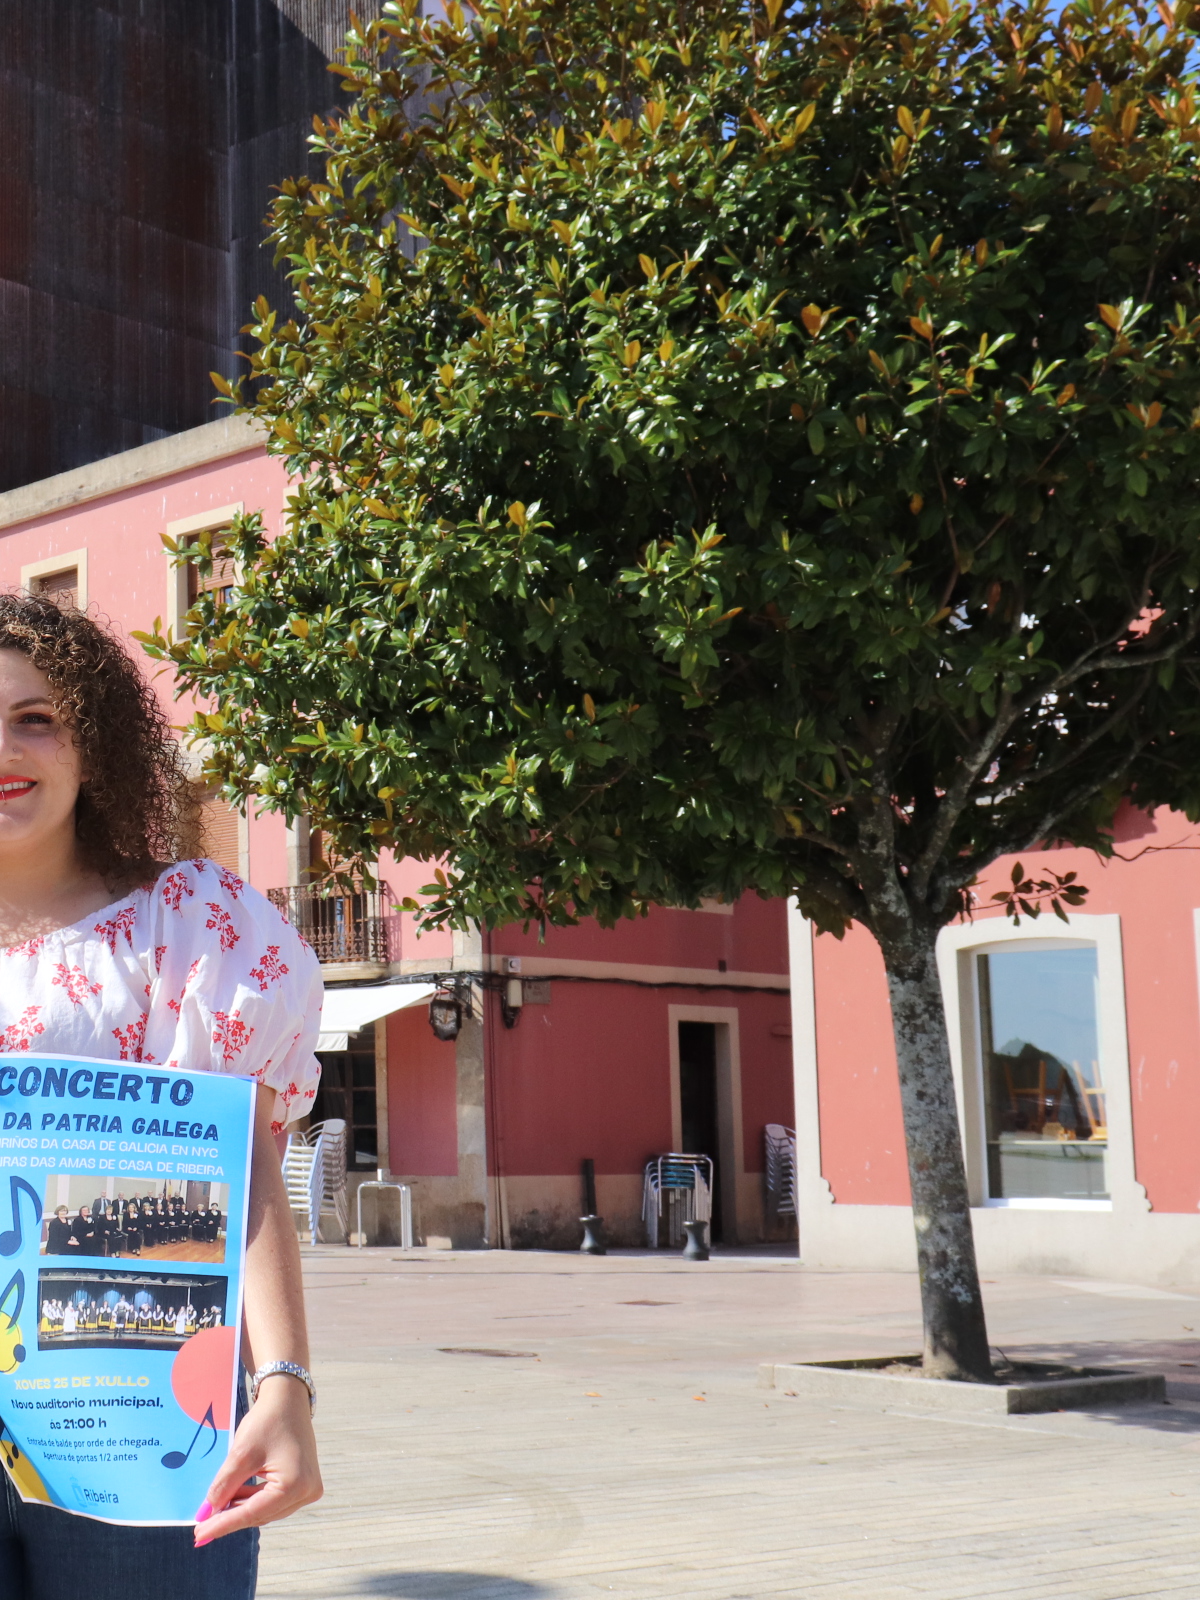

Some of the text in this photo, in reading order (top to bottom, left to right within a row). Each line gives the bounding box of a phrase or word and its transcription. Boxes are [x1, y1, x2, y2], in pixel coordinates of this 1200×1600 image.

[3, 1112, 32, 1130] DA
[41, 1113, 122, 1133] PATRIA
[132, 1117, 218, 1141] GALEGA
[41, 1138, 59, 1149] DA
[62, 1139, 96, 1150] CASA
[100, 1141, 116, 1151] DE
[119, 1140, 168, 1154] GALICIA
[172, 1144, 188, 1155] EN
[192, 1146, 218, 1158] NYC
[31, 1157, 56, 1168] DAS
[59, 1157, 96, 1169] AMAS
[99, 1158, 115, 1170] DE
[118, 1159, 153, 1171] CASA
[157, 1162, 173, 1173] DE
[177, 1163, 224, 1176] RIBEIRA
[14, 1376, 149, 1390] XOVES 25 DE XULLO
[11, 1396, 163, 1409] Novo auditorio municipal,
[63, 1418, 94, 1429] 21:00
[99, 1418, 106, 1428] h
[27, 1437, 46, 1446] Entrada
[55, 1440, 72, 1448] balde
[74, 1440, 84, 1451] por
[87, 1438, 104, 1447] orde
[106, 1438, 117, 1446] de
[120, 1438, 162, 1448] chegada.
[43, 1452, 137, 1463] Apertura de portas 1/2 antes
[83, 1488, 119, 1504] Ribeira
